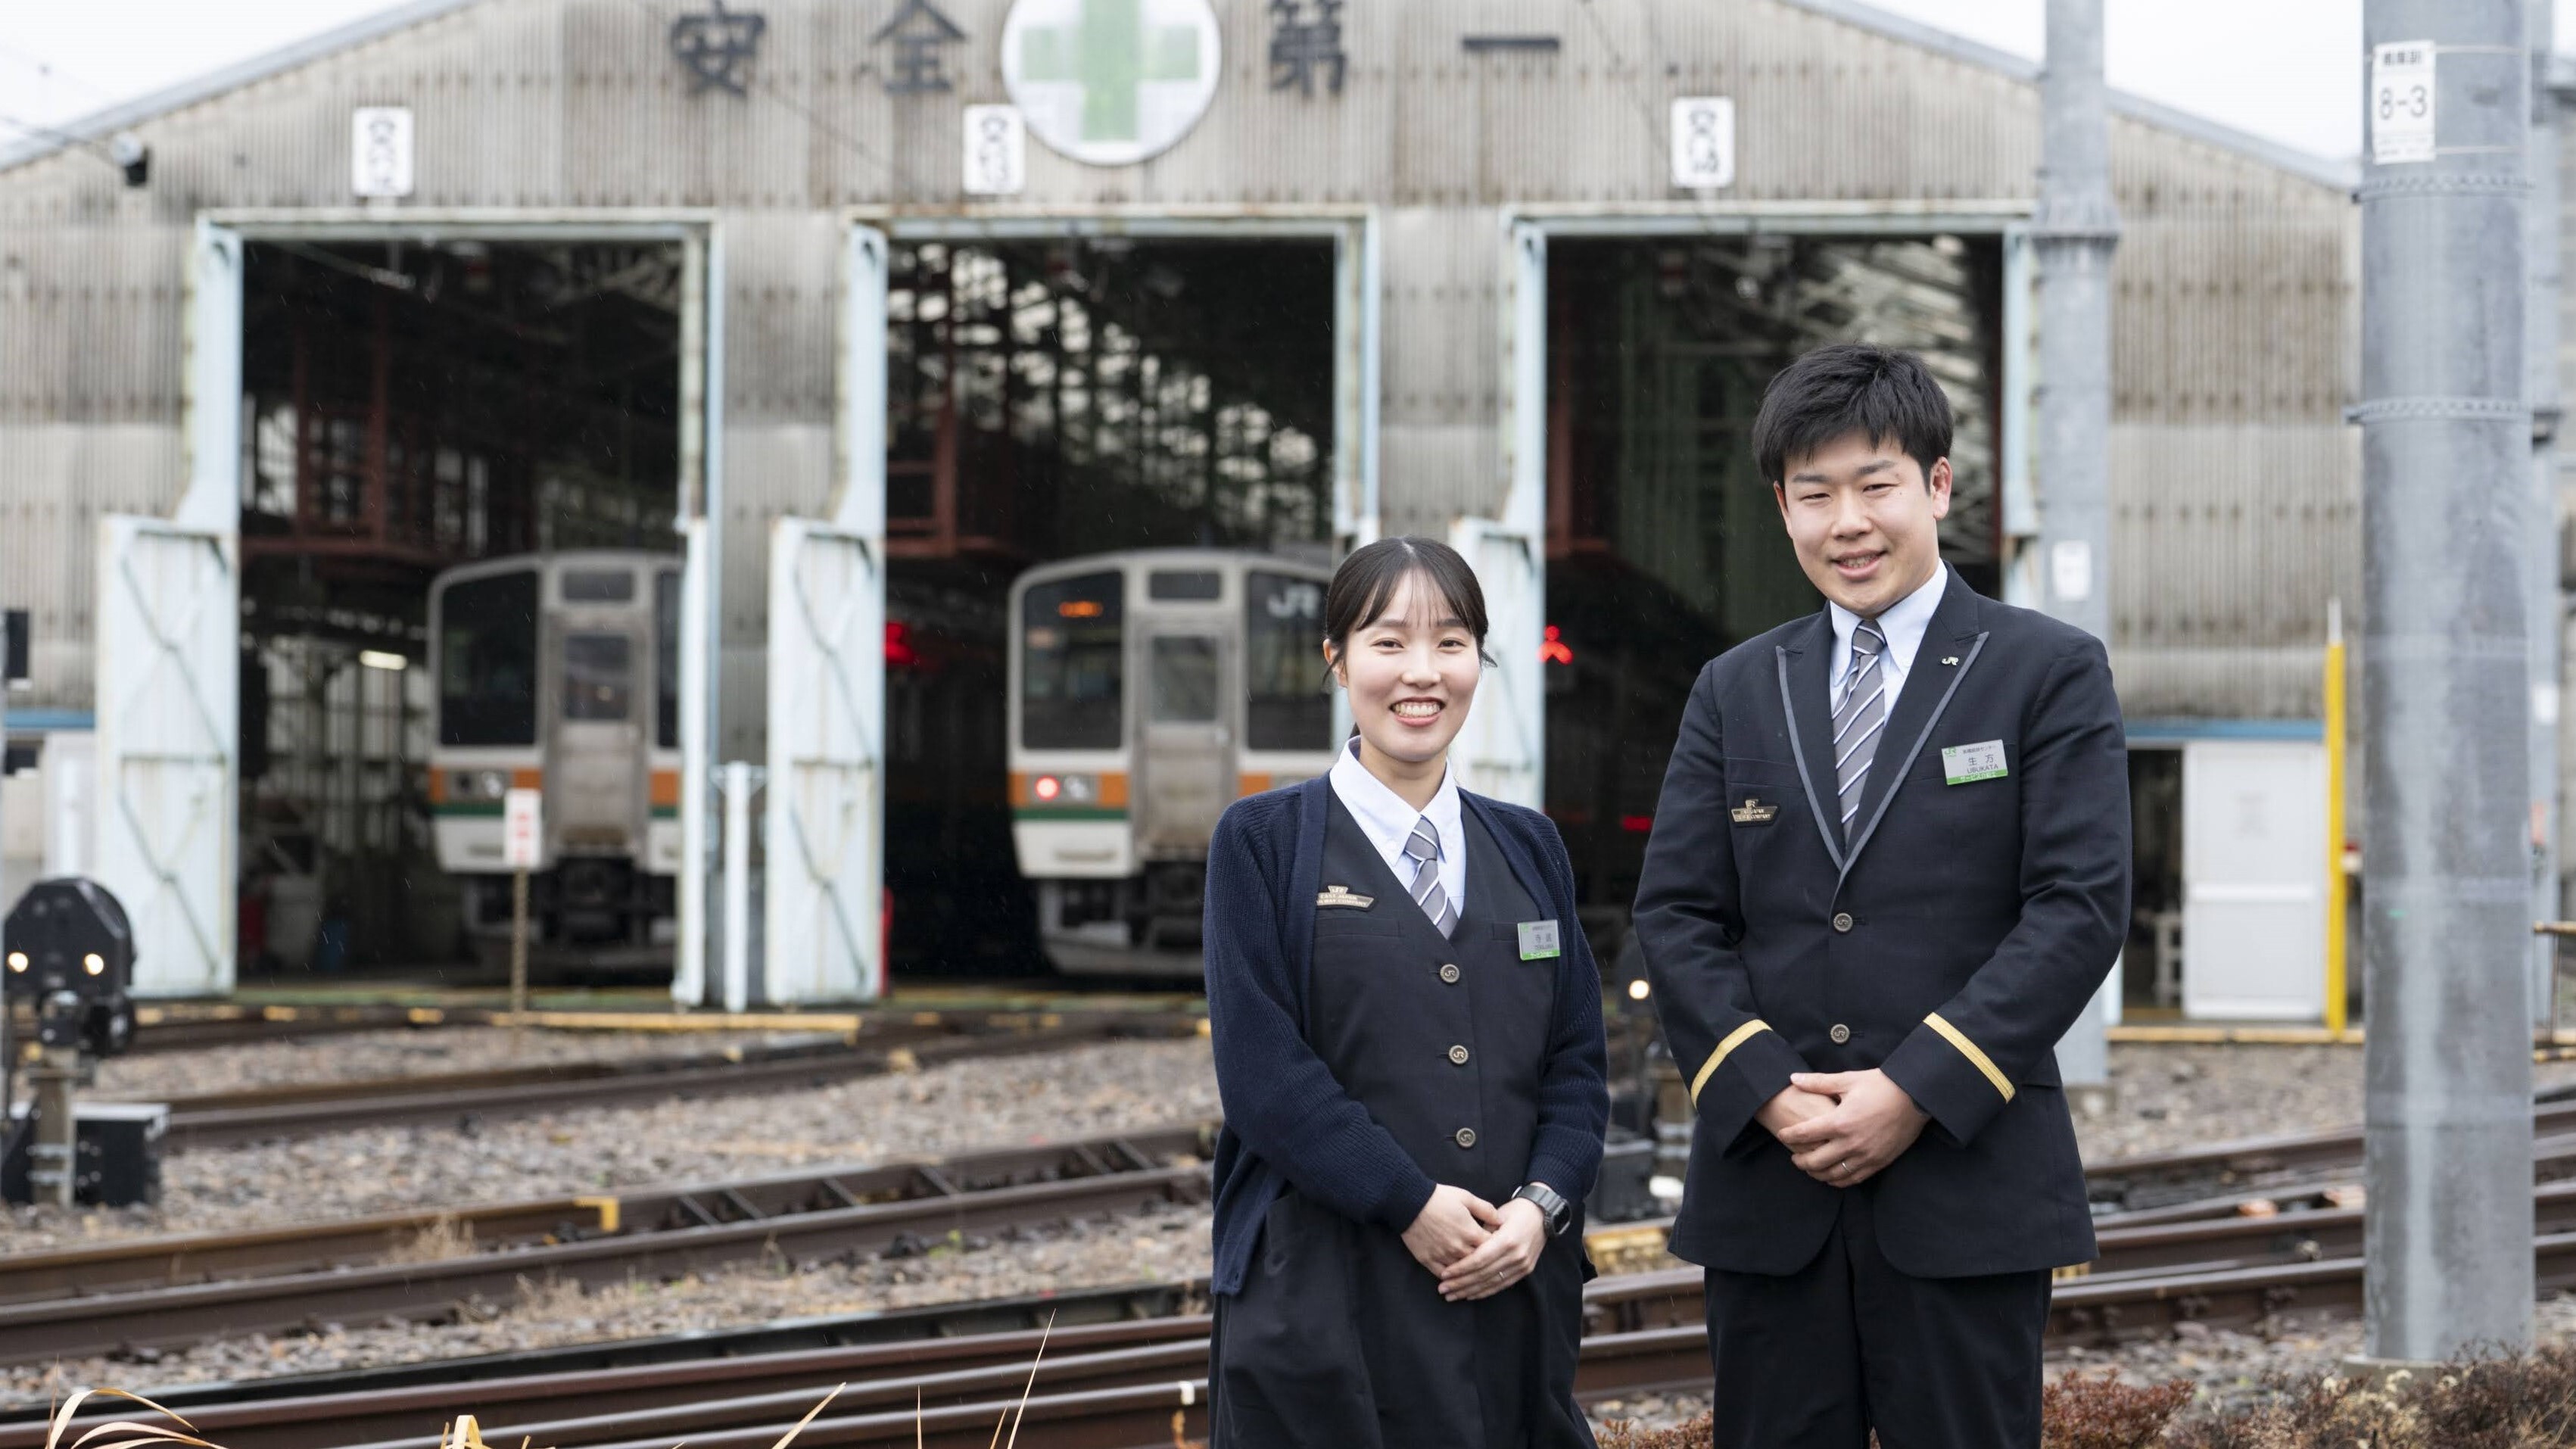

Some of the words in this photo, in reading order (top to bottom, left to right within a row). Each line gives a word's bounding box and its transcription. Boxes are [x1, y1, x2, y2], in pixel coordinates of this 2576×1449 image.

[2378, 85, 2428, 120] 8-3
[1266, 584, 1320, 619] JR
[1942, 656, 1959, 665] JR
